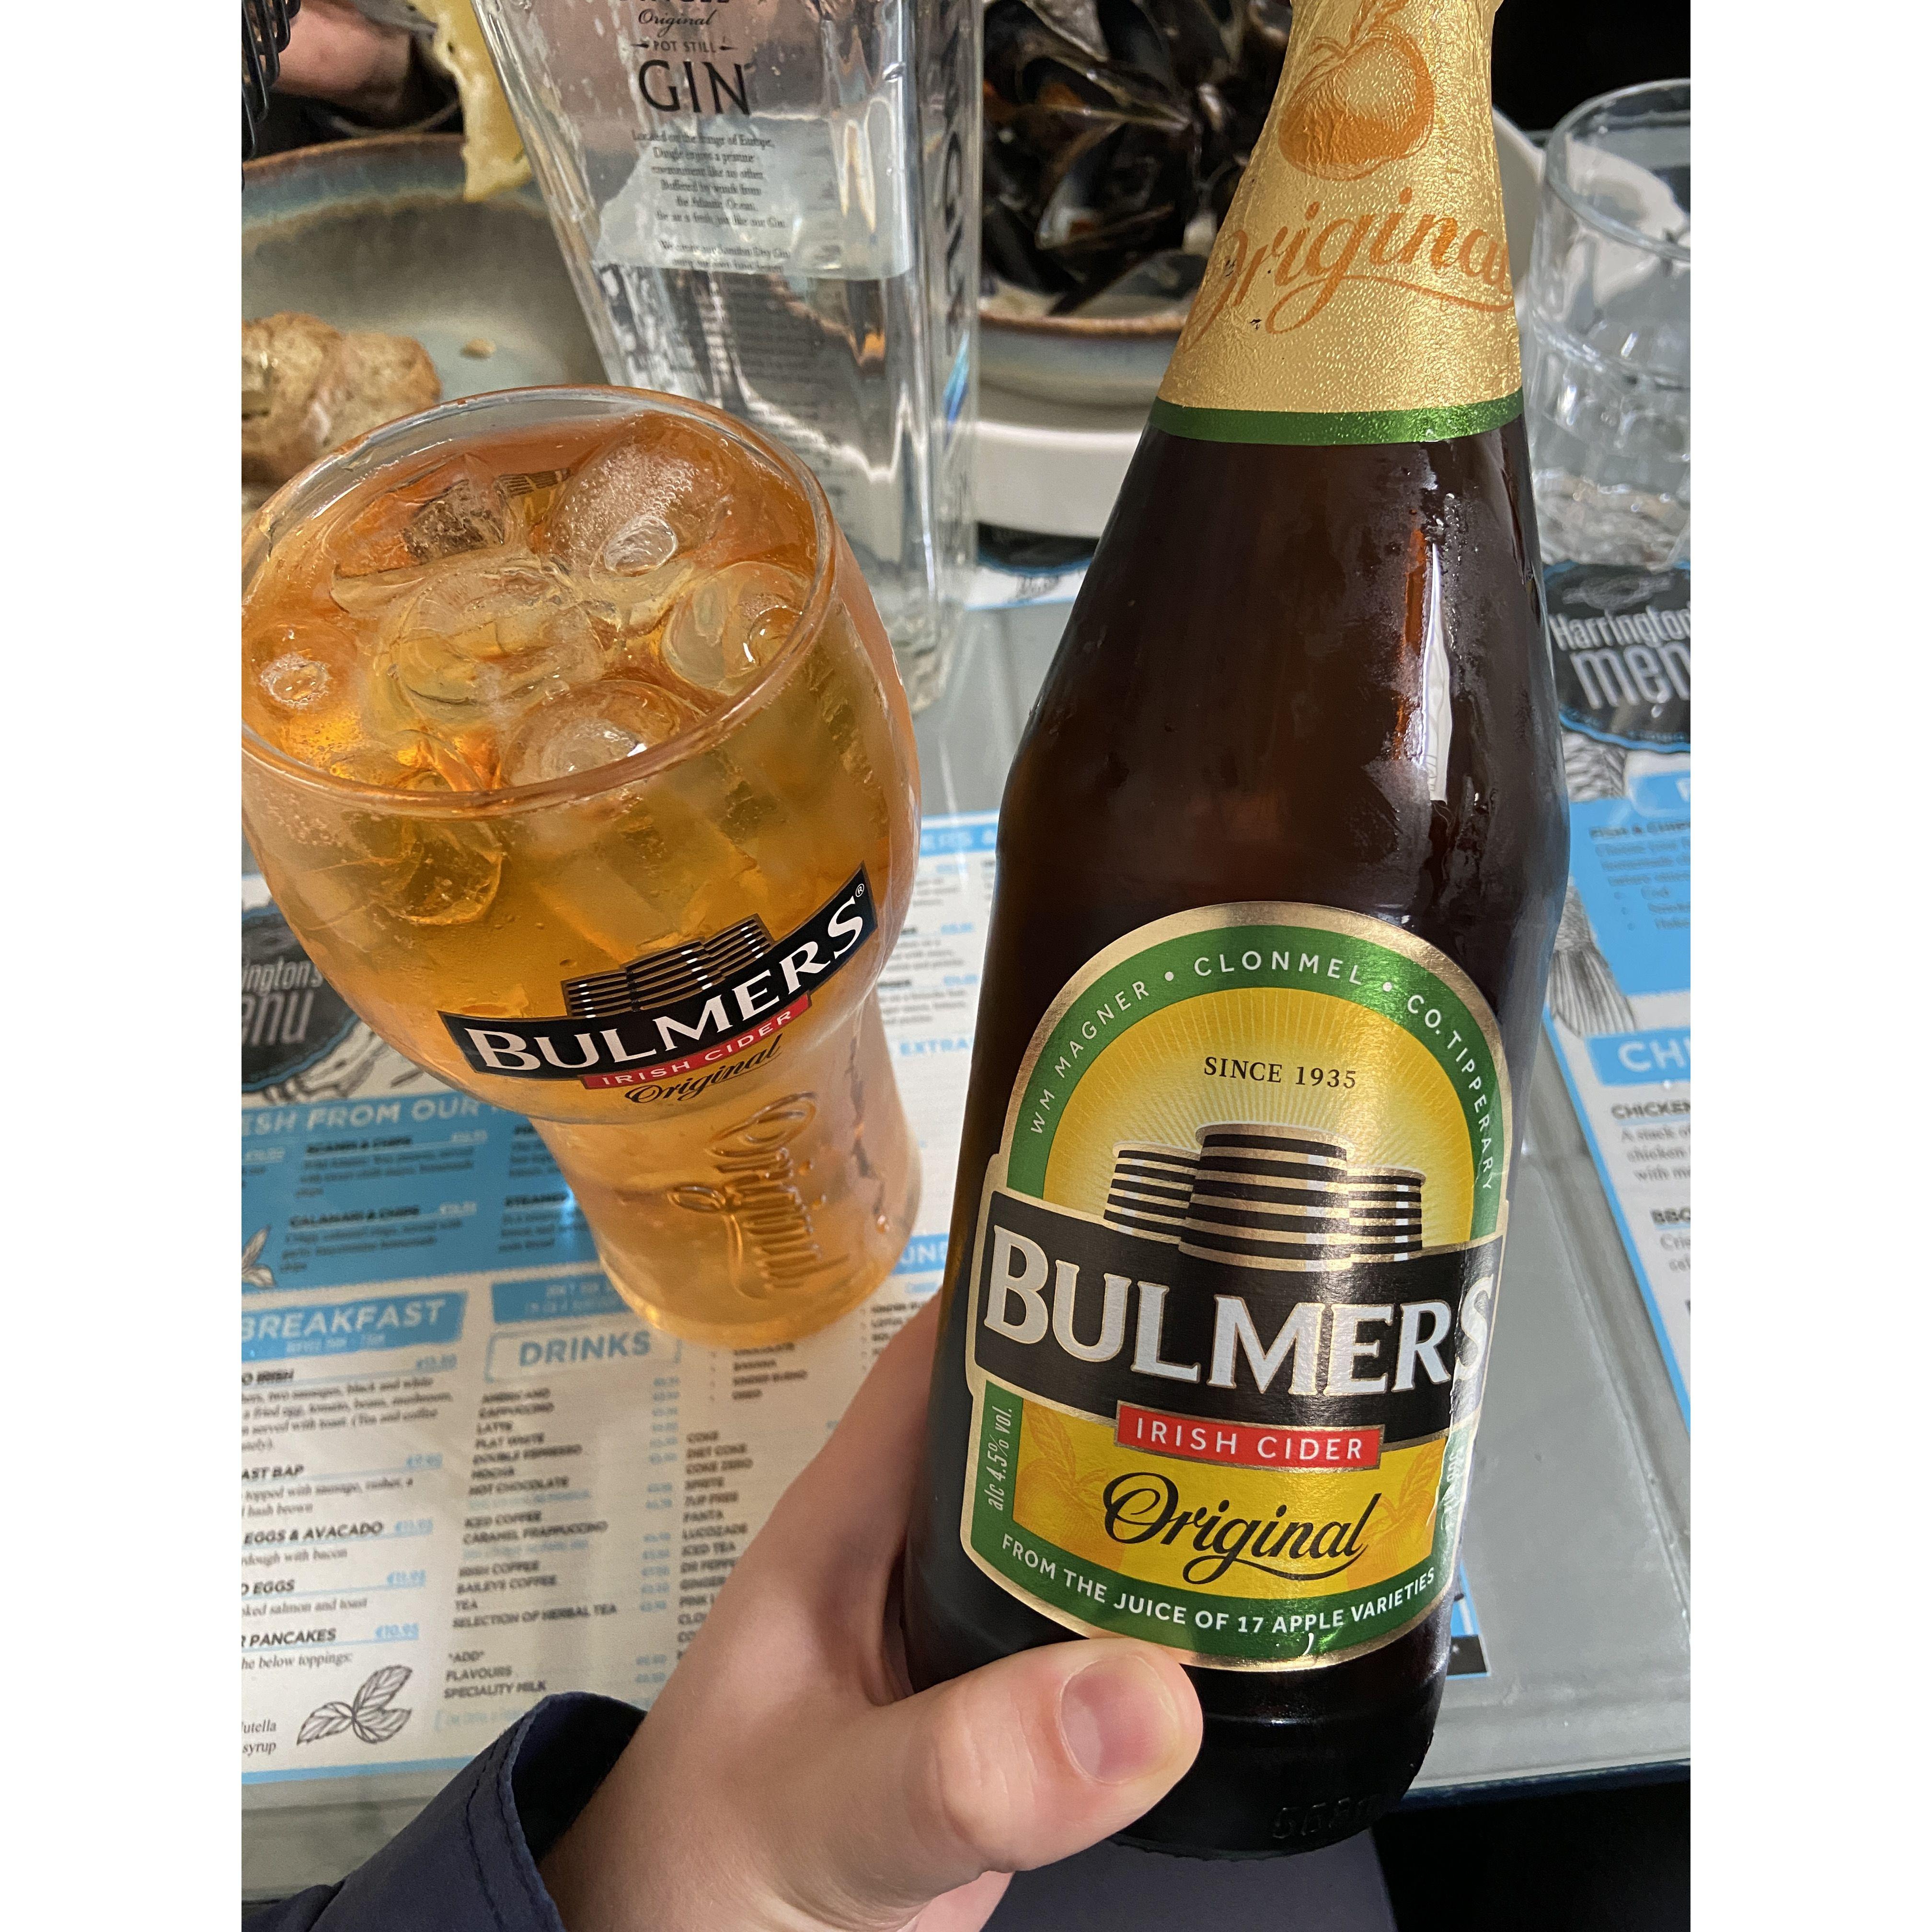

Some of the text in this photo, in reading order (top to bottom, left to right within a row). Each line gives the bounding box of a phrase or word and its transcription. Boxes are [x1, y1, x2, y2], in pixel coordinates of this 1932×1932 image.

[638, 9, 717, 38] Original
[654, 41, 716, 53] POT STILL
[639, 59, 750, 115] GIN
[464, 896, 864, 1071] BULMERS
[1194, 951, 1362, 985] CLONMEL
[602, 1011, 792, 1085] IRISH CIDER
[1031, 981, 1149, 1133] WM MAGNER
[624, 1033, 784, 1103] Original
[1204, 1057, 1356, 1089] SINCE 1935
[307, 1103, 402, 1131] FROM
[411, 1097, 480, 1122] OUR
[242, 1299, 446, 1340] BREAKFAST
[983, 1225, 1494, 1397] BULMERS
[519, 1331, 651, 1368] DRINKS
[1136, 1417, 1362, 1460] IRISH CIDER
[984, 1406, 1012, 1511] alc 4.5% vol.
[244, 1521, 384, 1545] EGGS & AVACADO
[1103, 1472, 1382, 1585] Original
[253, 1579, 295, 1595] EGGS
[1002, 1533, 1435, 1633] FROM THE JUICE OF 17 APPLE VARIETIES
[250, 1628, 337, 1647] PANCAKES
[258, 1655, 295, 1669] below
[242, 1742, 276, 1757] syrup
